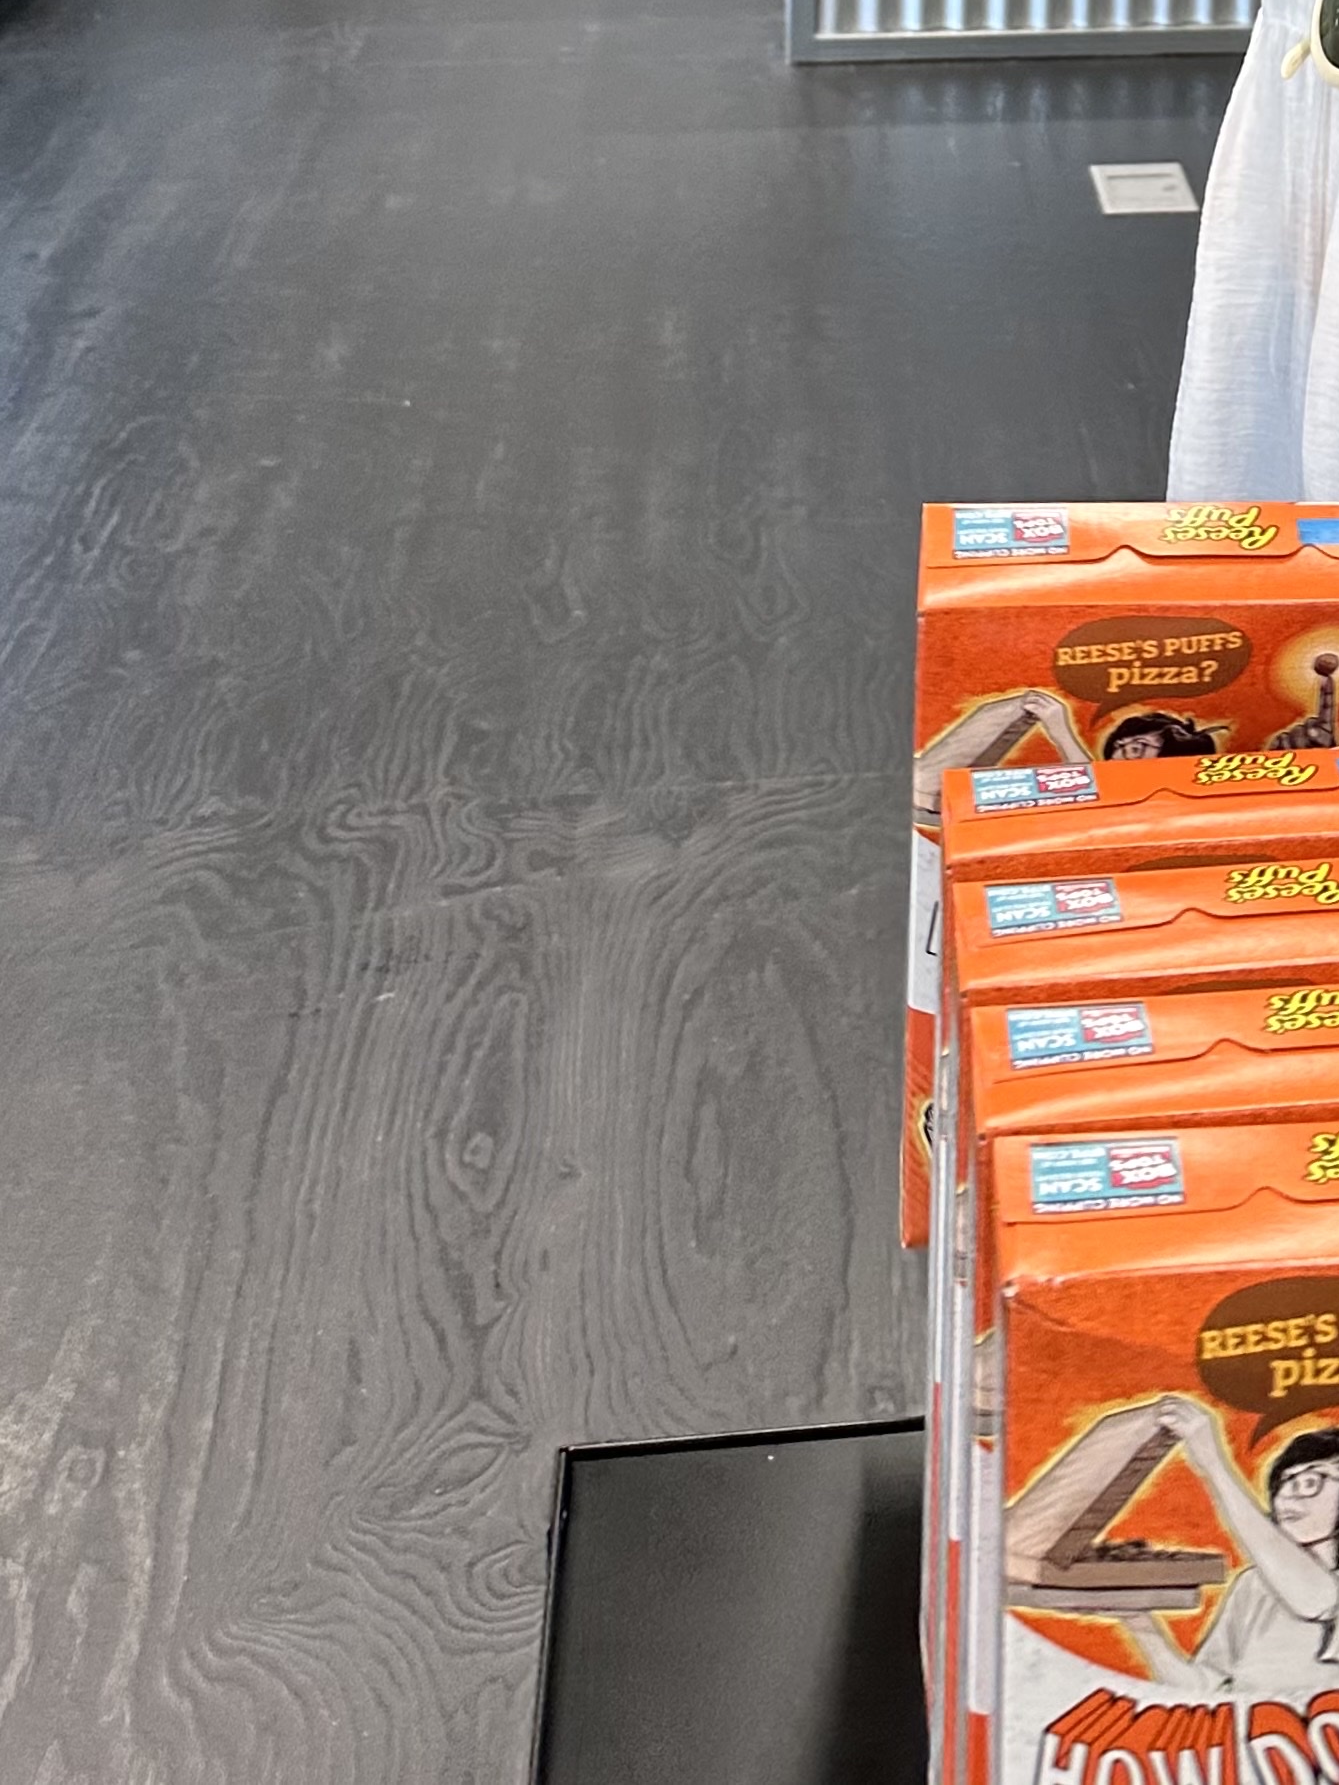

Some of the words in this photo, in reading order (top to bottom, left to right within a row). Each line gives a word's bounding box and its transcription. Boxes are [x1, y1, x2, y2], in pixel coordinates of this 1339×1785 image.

[1167, 506, 1261, 529] Puffs
[1159, 525, 1280, 550] Reese's
[1056, 640, 1159, 666] REESE'S
[1164, 631, 1243, 656] PUFFS
[1106, 660, 1218, 692] pizza?
[1195, 751, 1297, 770] Puffs
[1192, 764, 1319, 786] Reese's
[1225, 862, 1333, 887] Puffs
[1200, 1313, 1338, 1360] REESE'S
